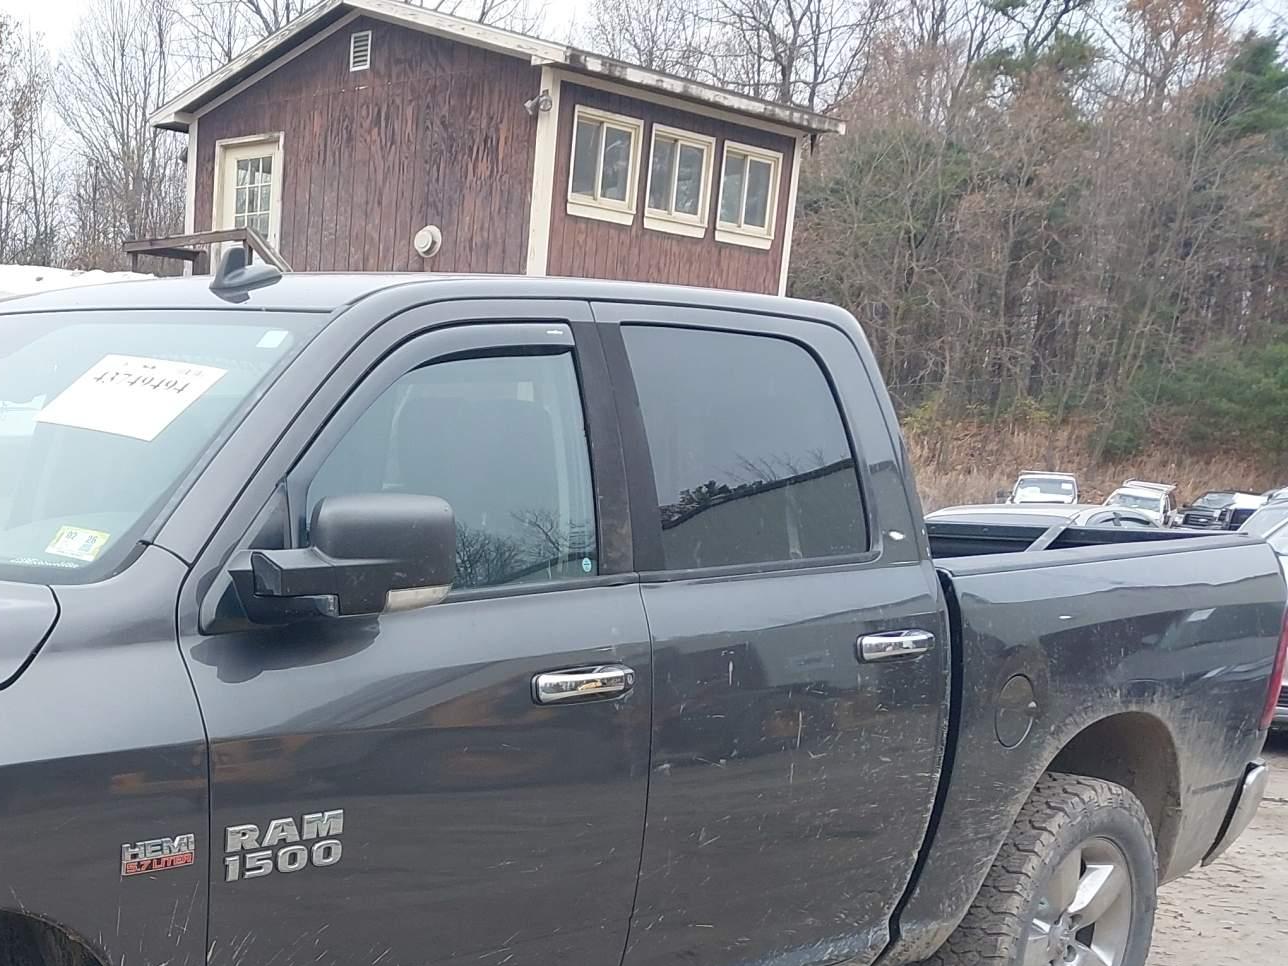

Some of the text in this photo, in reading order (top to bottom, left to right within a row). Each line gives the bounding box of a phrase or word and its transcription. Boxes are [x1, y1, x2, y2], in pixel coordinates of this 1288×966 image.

[121, 833, 195, 862] HEMI
[225, 809, 345, 852] RAM
[126, 852, 192, 873] 5.7 LITER
[224, 839, 344, 882] 1500
